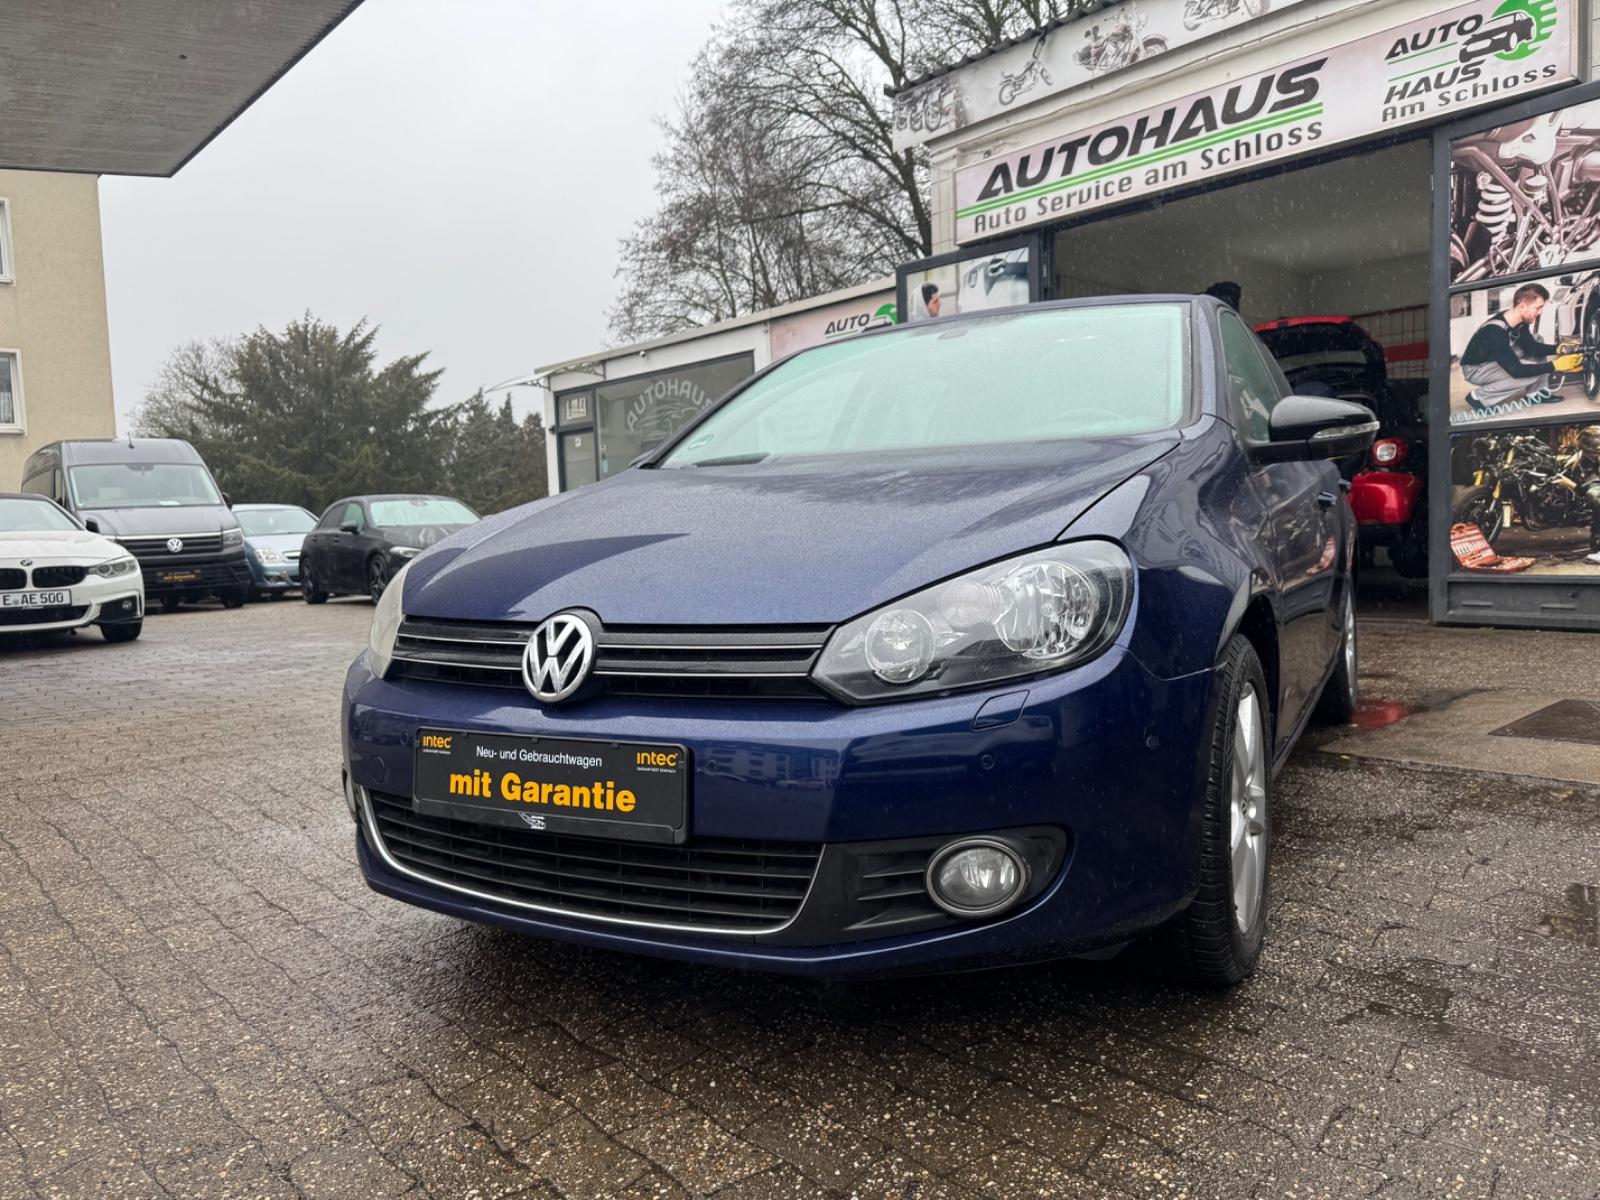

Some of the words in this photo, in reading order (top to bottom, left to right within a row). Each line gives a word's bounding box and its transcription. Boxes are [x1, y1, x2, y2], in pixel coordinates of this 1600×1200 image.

[1384, 14, 1483, 60] AUTO
[1382, 101, 1425, 122] Am
[1438, 64, 1557, 106] Schloss
[1384, 59, 1486, 104] HAUS
[976, 56, 1331, 202] AUTOHAUS
[974, 204, 1026, 233] Auto
[1037, 174, 1132, 216] Service
[1145, 158, 1187, 185] am
[1200, 121, 1323, 170] Schloss
[824, 314, 870, 335] AUTO
[3, 595, 11, 606] E
[21, 593, 37, 605] AE
[40, 592, 64, 603] 500
[476, 745, 497, 758] Neu-
[500, 749, 517, 760] und
[519, 748, 602, 769] Gebrauchtwagen
[449, 769, 492, 797] mit
[501, 772, 636, 812] Garantie
